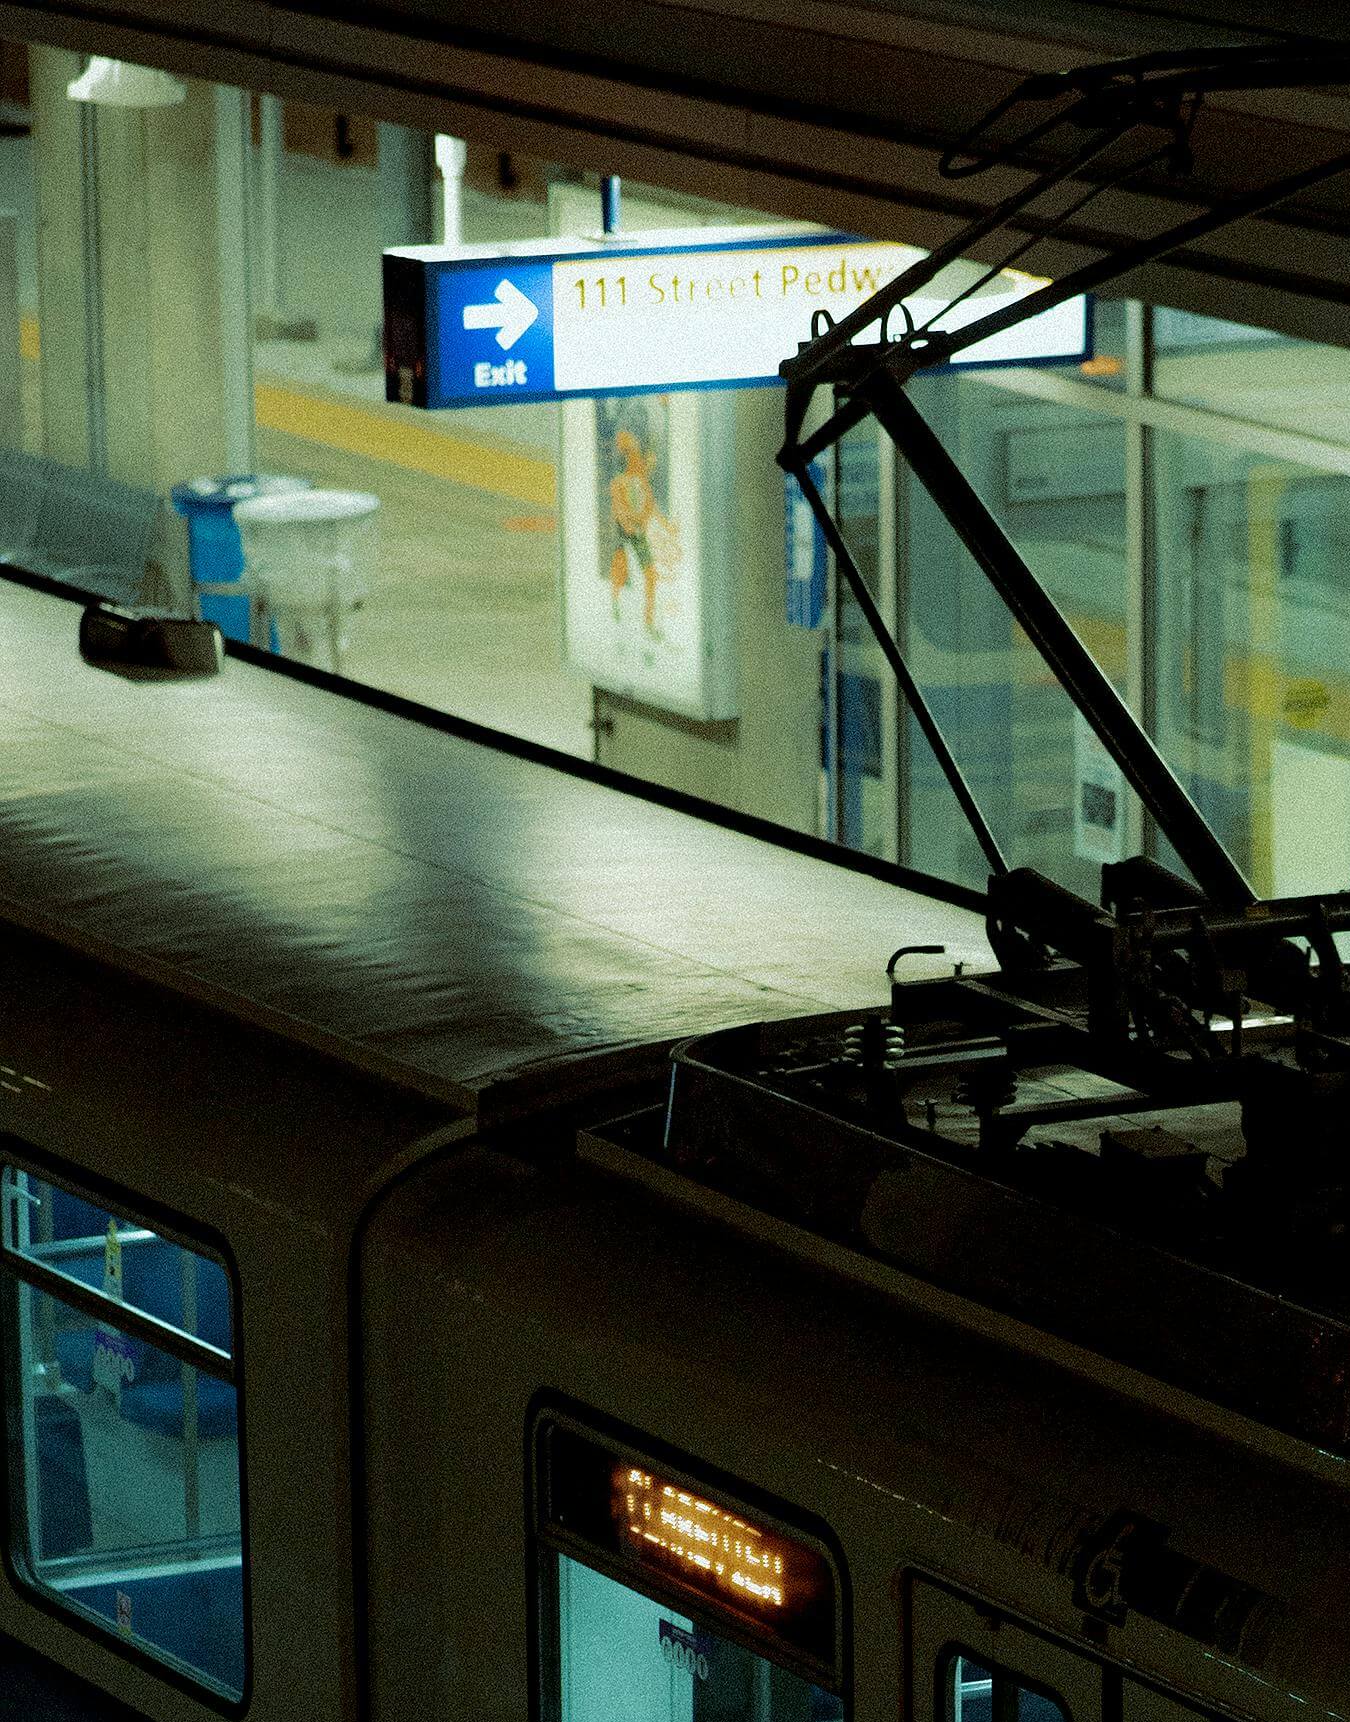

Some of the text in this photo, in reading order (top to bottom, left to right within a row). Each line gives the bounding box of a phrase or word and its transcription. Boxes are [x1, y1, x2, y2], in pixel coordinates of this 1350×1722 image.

[574, 256, 894, 310] 111 Street Pedw
[473, 359, 529, 389] Exit
